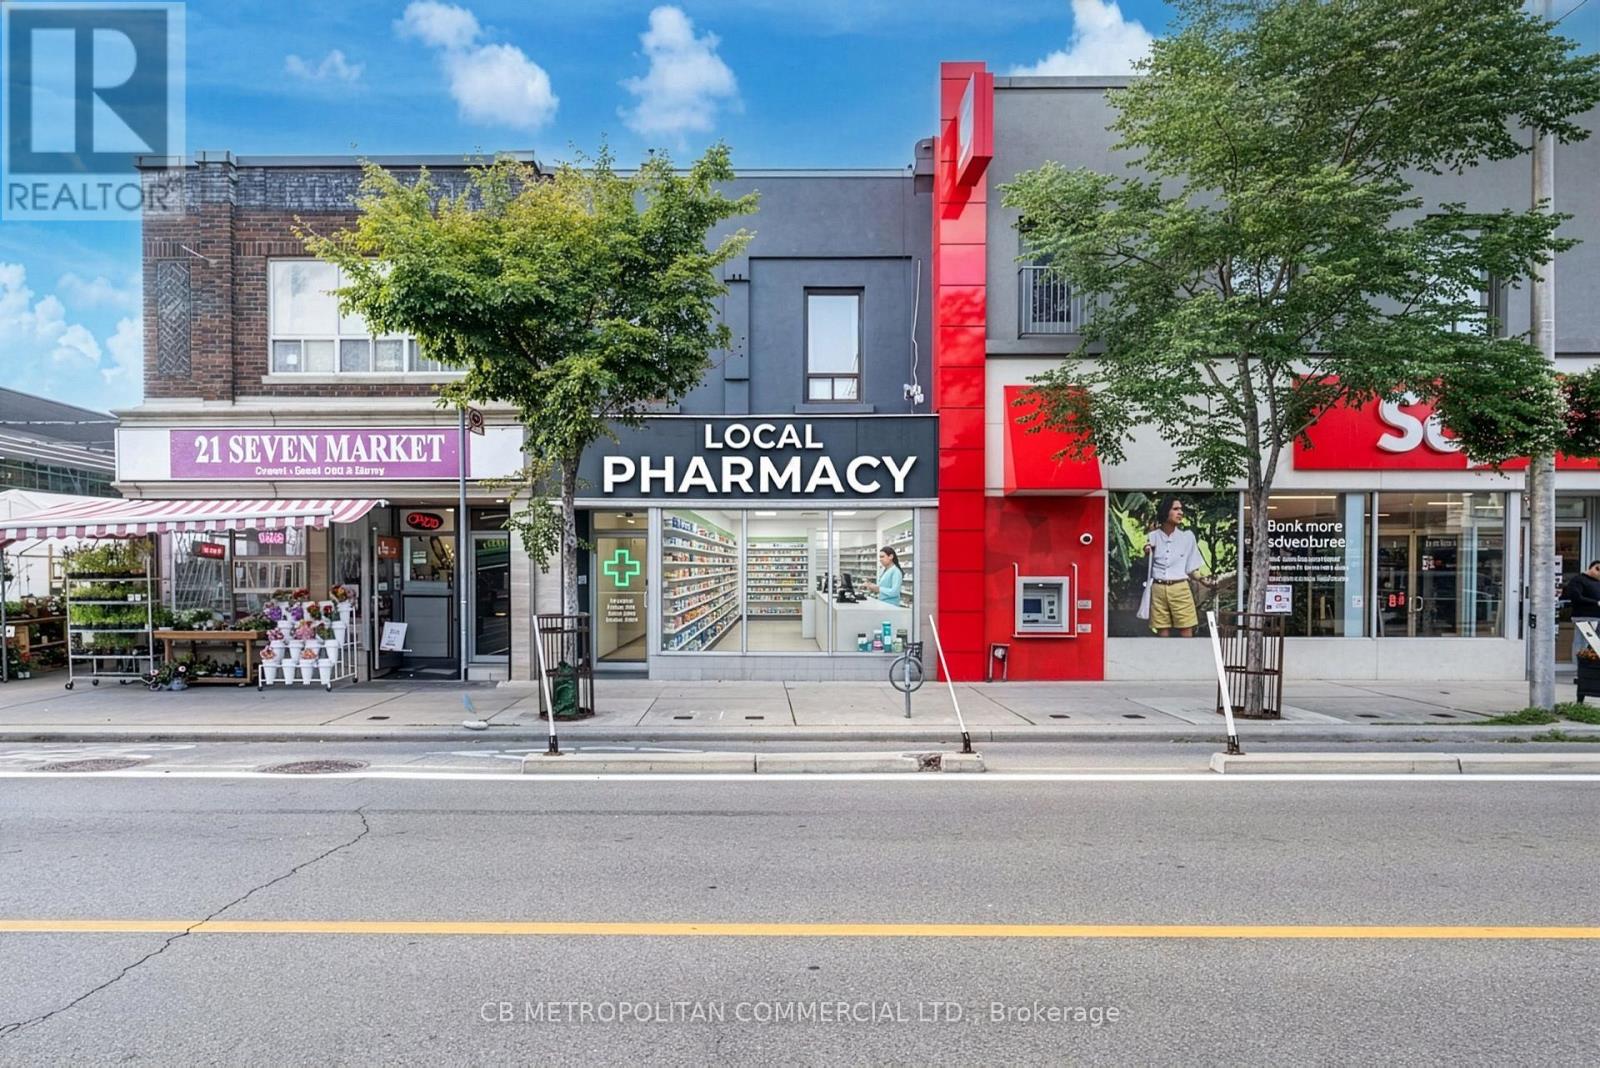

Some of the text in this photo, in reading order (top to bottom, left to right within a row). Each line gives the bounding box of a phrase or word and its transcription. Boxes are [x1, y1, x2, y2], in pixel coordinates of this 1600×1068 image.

[194, 435, 445, 464] 21 SEVEN MARKET
[705, 423, 824, 449] LOCAL
[603, 455, 918, 494] PHARMACY
[1305, 522, 1343, 532] more
